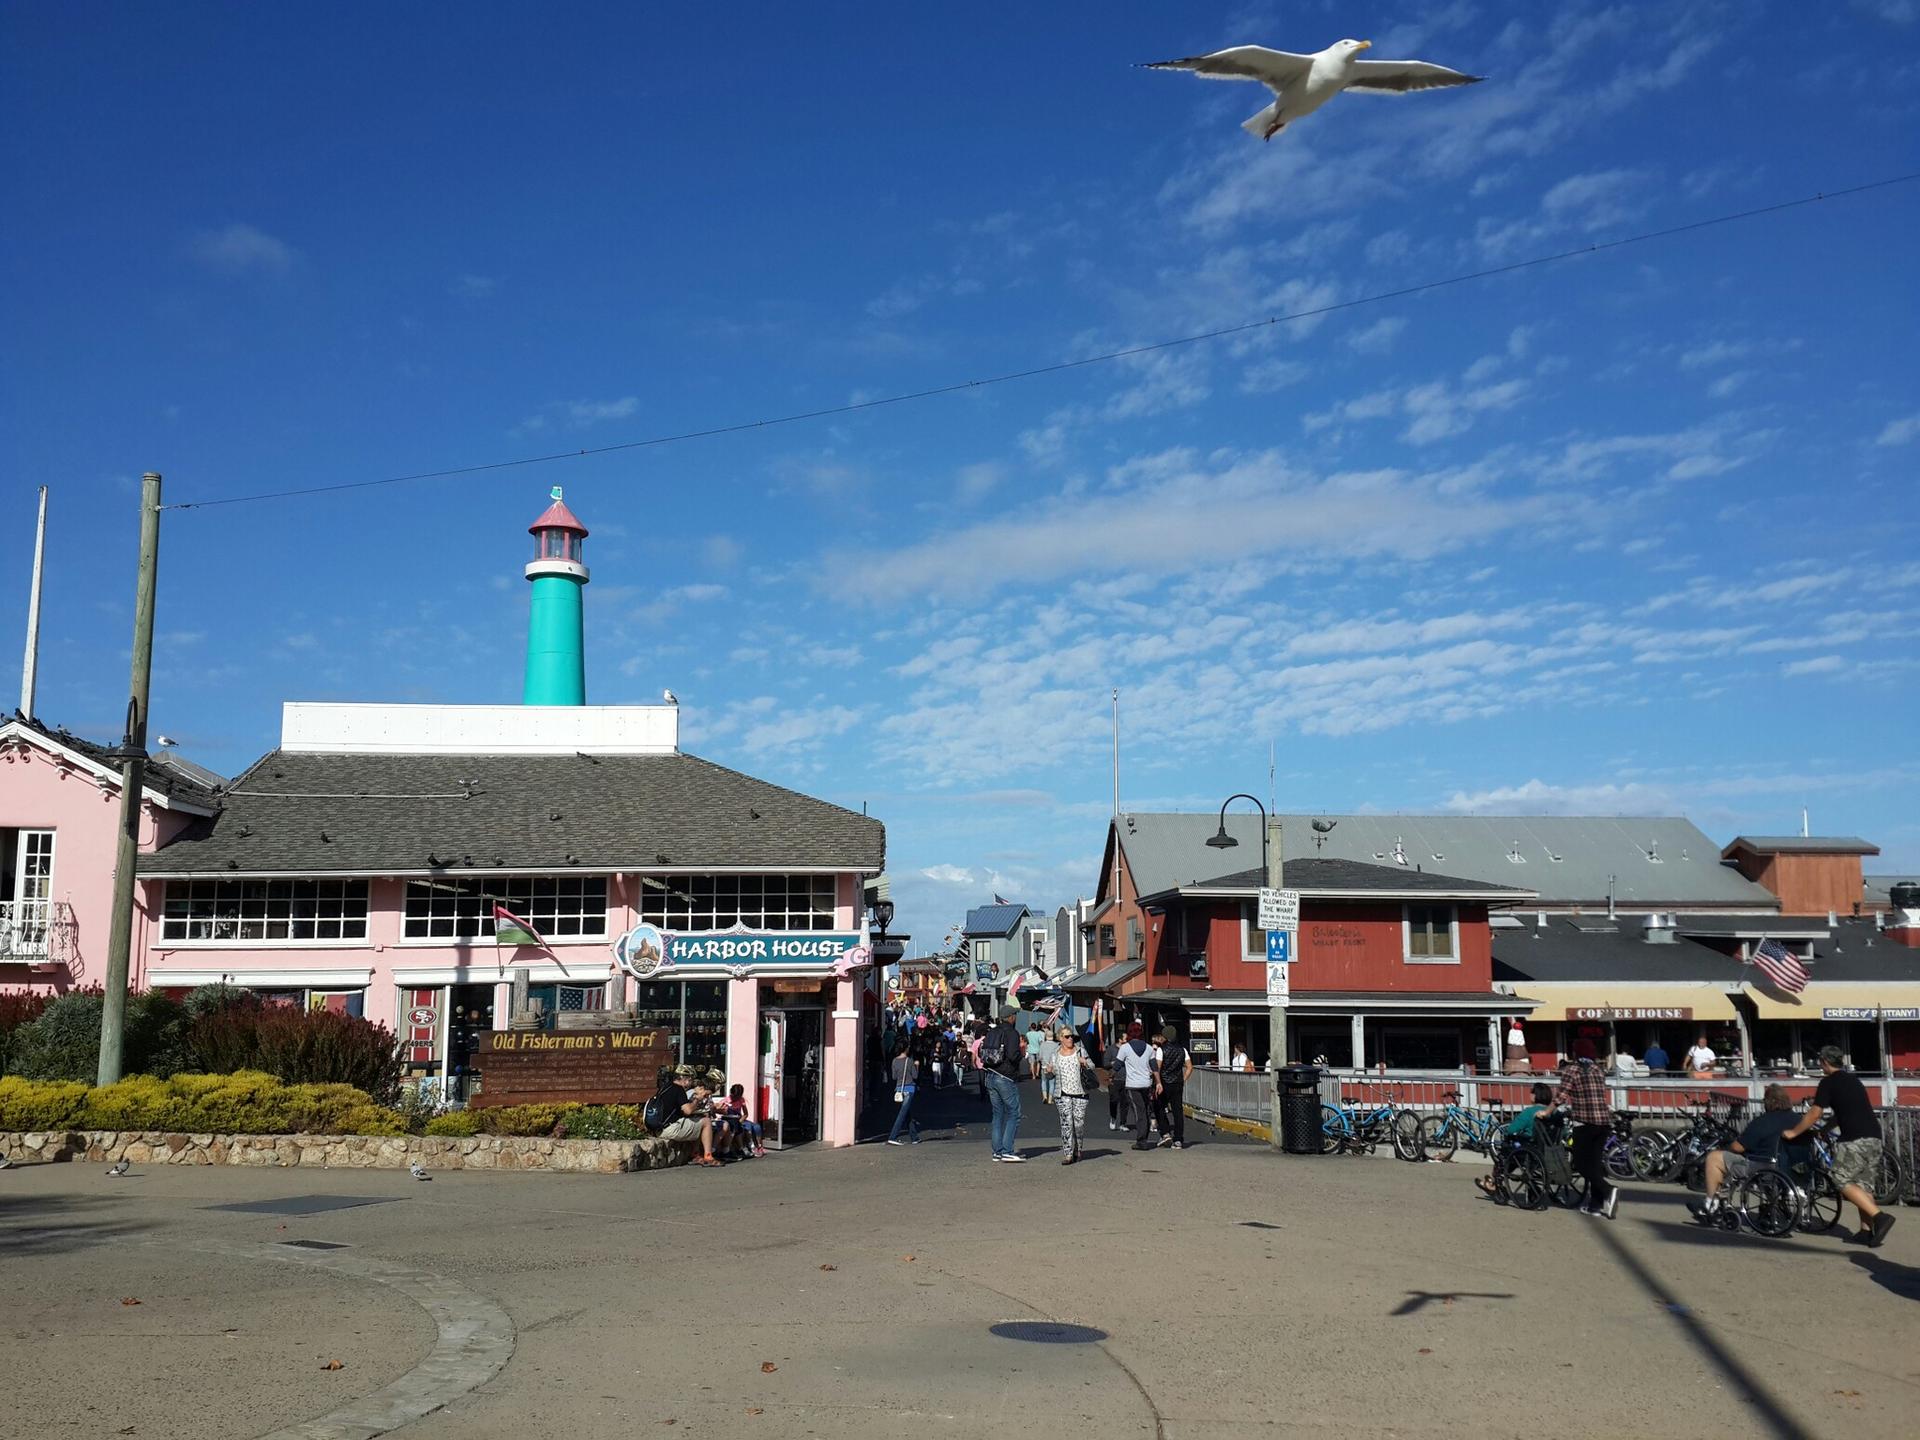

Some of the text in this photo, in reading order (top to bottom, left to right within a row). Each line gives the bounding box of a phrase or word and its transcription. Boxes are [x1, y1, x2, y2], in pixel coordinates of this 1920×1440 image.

[1271, 891, 1297, 899] VEHICLES
[1263, 898, 1287, 906] ALLOWED
[672, 939, 845, 960] HARBOR HOUSE
[1577, 1009, 1683, 1018] COFEE HOUSE
[492, 1031, 658, 1050] Old Fisherman's Wharf
